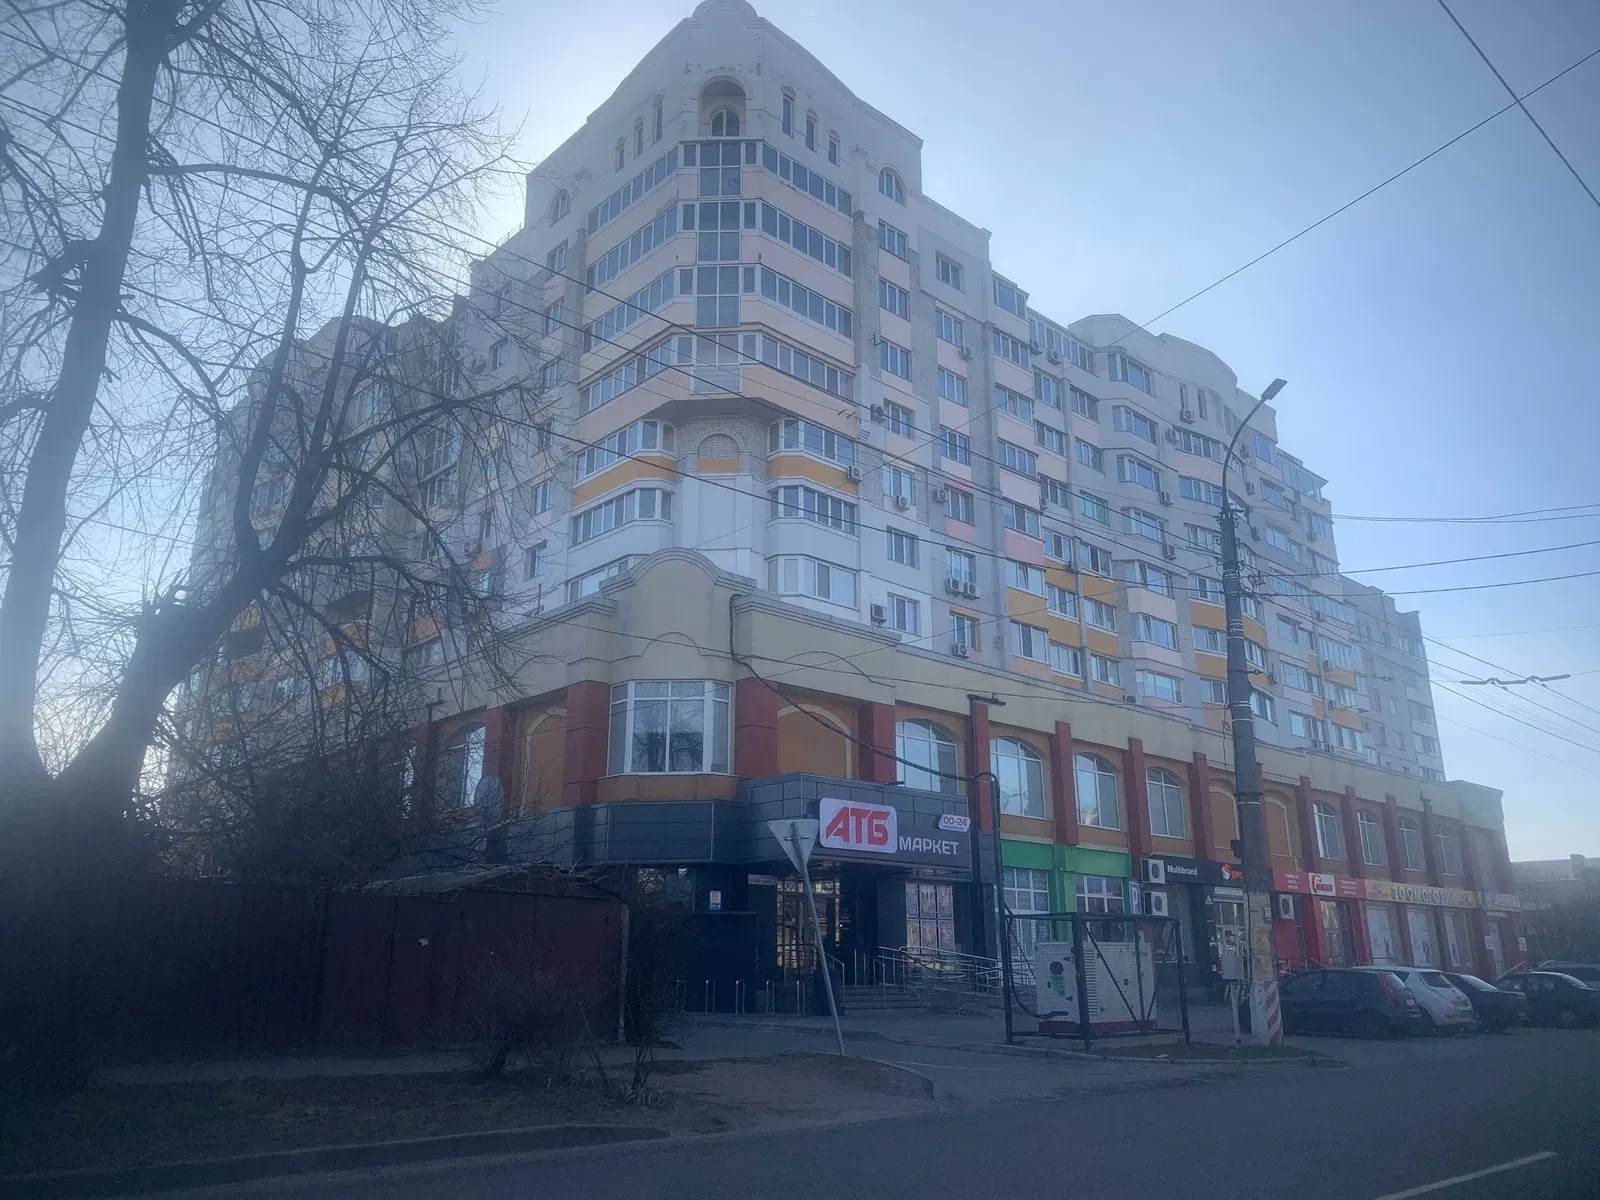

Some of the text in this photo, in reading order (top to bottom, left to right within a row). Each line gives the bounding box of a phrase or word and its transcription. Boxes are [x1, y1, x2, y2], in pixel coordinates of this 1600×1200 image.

[826, 806, 891, 846] АТБ
[943, 816, 967, 827] 00-24
[899, 835, 959, 856] МАРКЕТ
[1167, 864, 1198, 876] Multibrand
